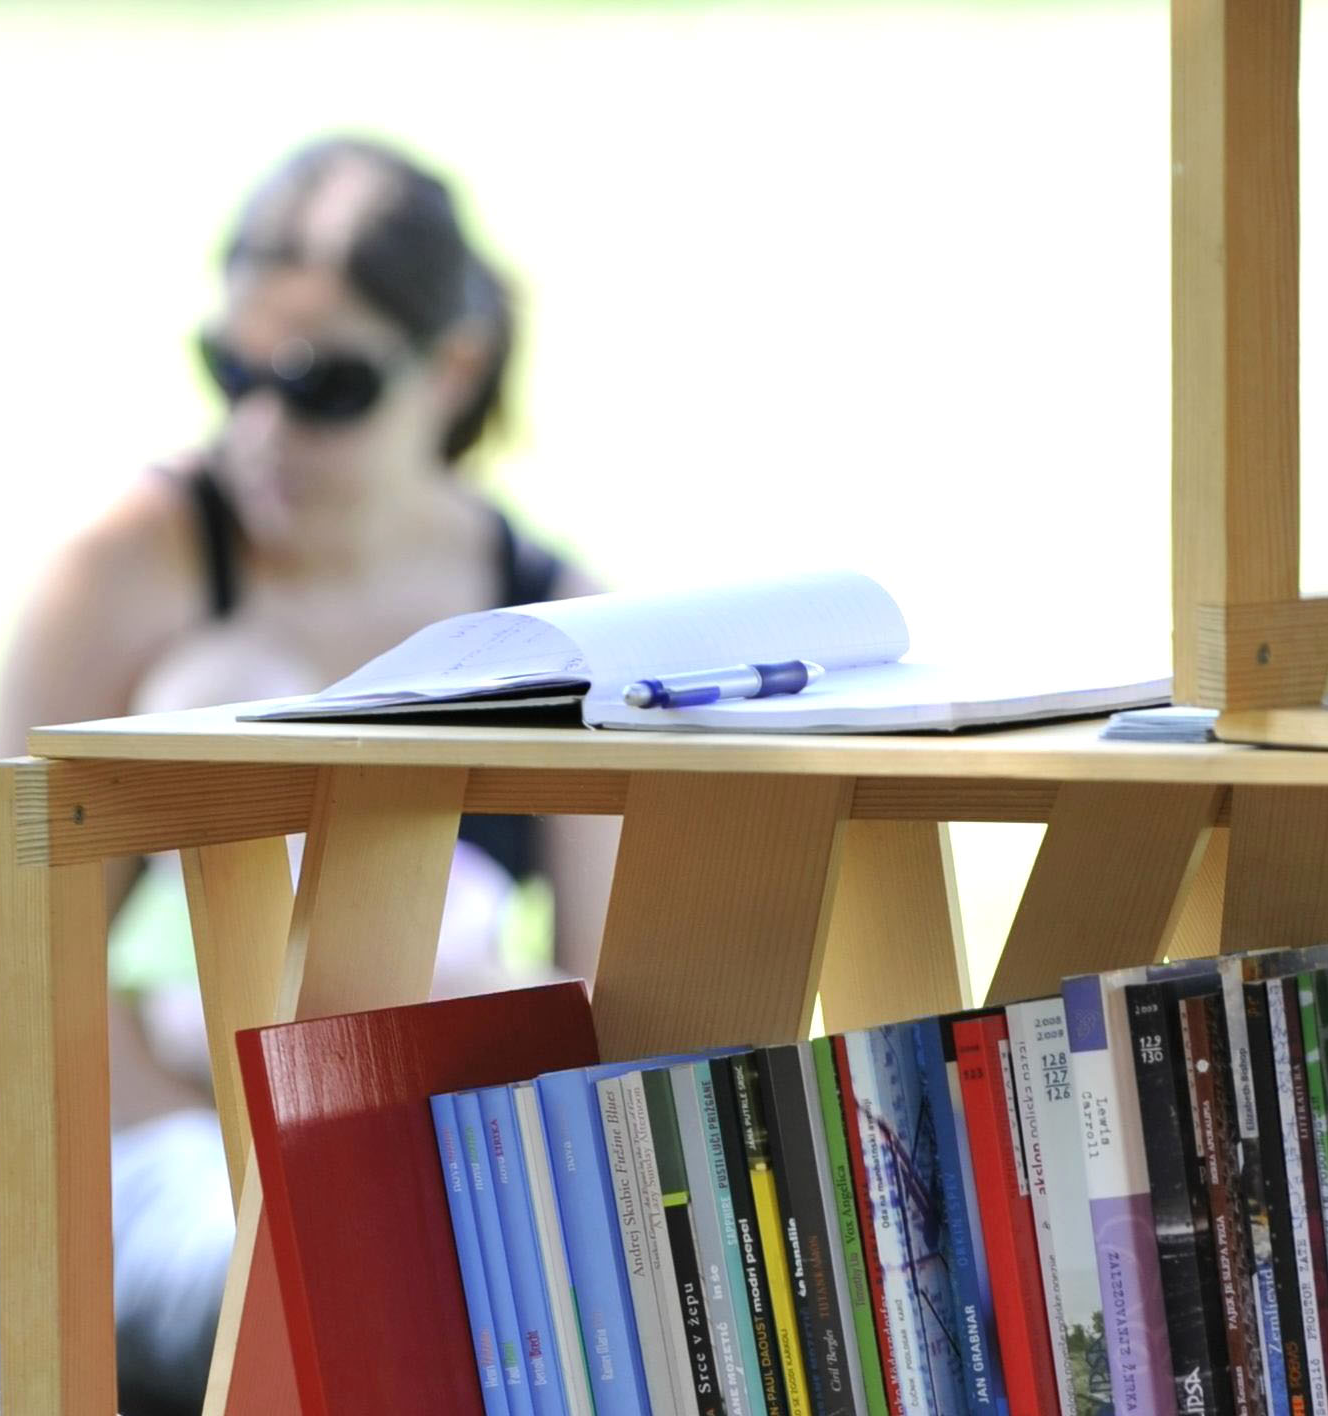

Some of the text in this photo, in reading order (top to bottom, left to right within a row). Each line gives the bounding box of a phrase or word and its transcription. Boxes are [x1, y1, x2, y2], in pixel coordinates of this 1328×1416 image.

[1042, 1051, 1068, 1067] 128
[1138, 1034, 1163, 1049] 129
[1141, 1049, 1165, 1064] 130
[1044, 1069, 1070, 1085] 127
[1046, 1086, 1071, 1102] 126
[1236, 1047, 1256, 1131] Elizabeth Bishop
[1291, 1062, 1310, 1139] LITERATURA
[601, 1088, 620, 1124] Blues
[1079, 1091, 1100, 1159] Carroll
[607, 1127, 628, 1175] Fužine
[698, 1078, 738, 1246] SAPPHIRE PUSTI LUČI PRIŽGANE
[616, 1176, 637, 1226] Skubic
[625, 1228, 648, 1278] Andrej
[737, 1216, 757, 1264] pepel
[1295, 1237, 1310, 1272] ZATE
[681, 1280, 703, 1327] žepu
[746, 1266, 763, 1313] modri
[1258, 1266, 1283, 1355] Zemljevid
[1300, 1280, 1319, 1341] PROSTOR
[753, 1313, 772, 1366] DAOUST
[964, 1303, 985, 1372] GRABNAR
[691, 1351, 712, 1394] Srce
[974, 1375, 990, 1404] JAN
